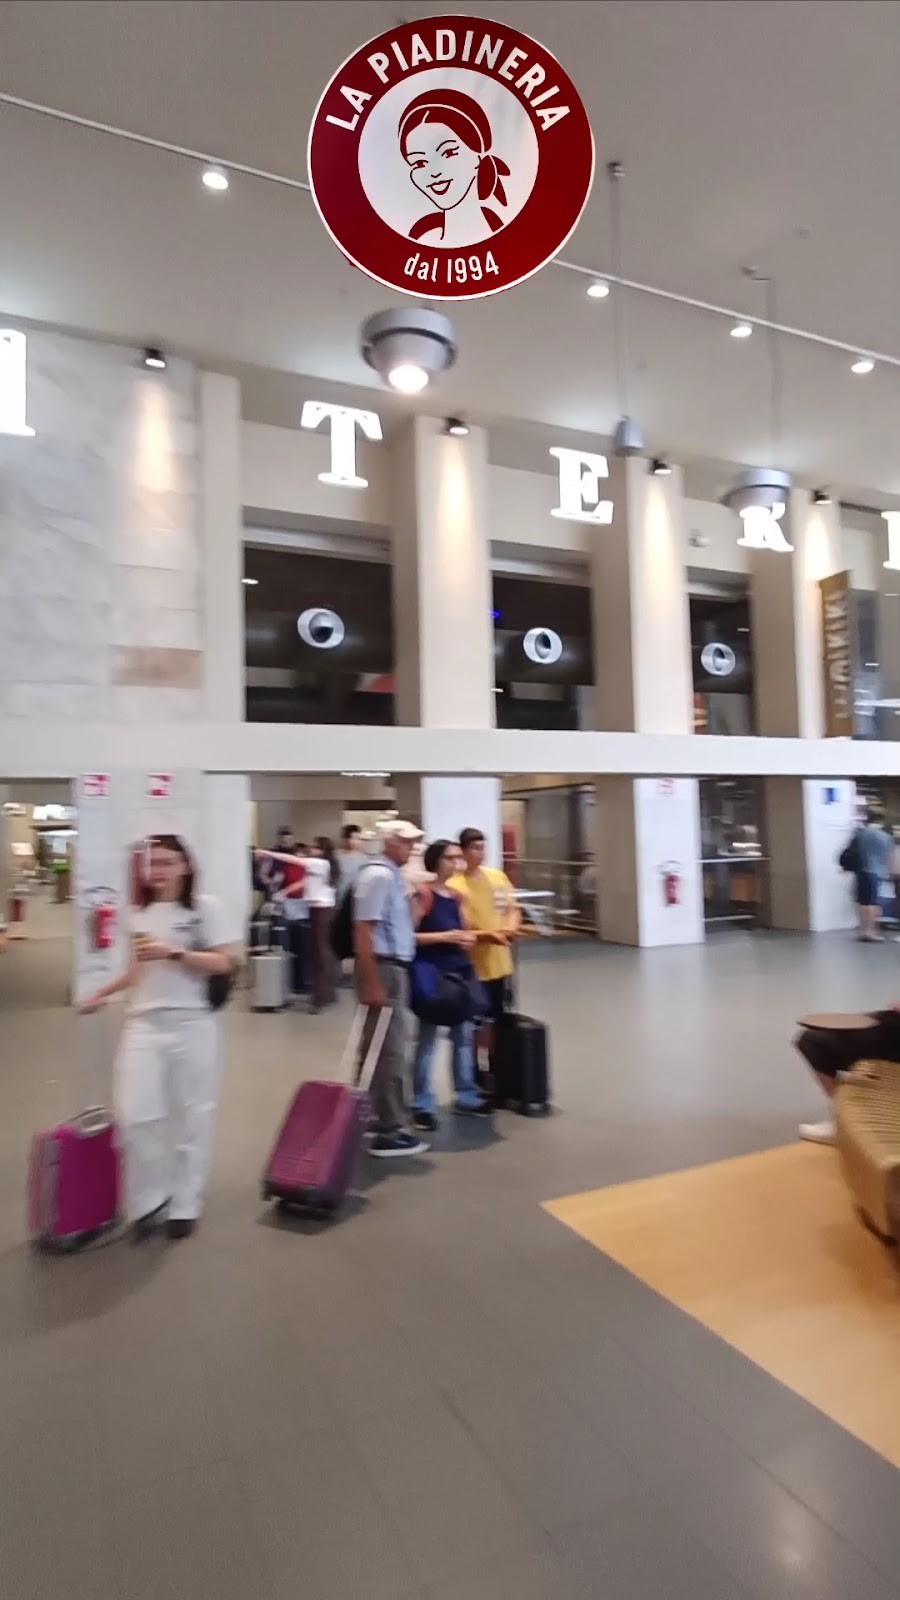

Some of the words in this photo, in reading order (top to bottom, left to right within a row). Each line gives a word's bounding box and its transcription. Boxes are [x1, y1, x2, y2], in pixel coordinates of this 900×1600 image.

[325, 84, 373, 132] LA
[367, 29, 570, 131] PIADINERIA
[403, 252, 439, 282] dal
[446, 250, 499, 284] 1994
